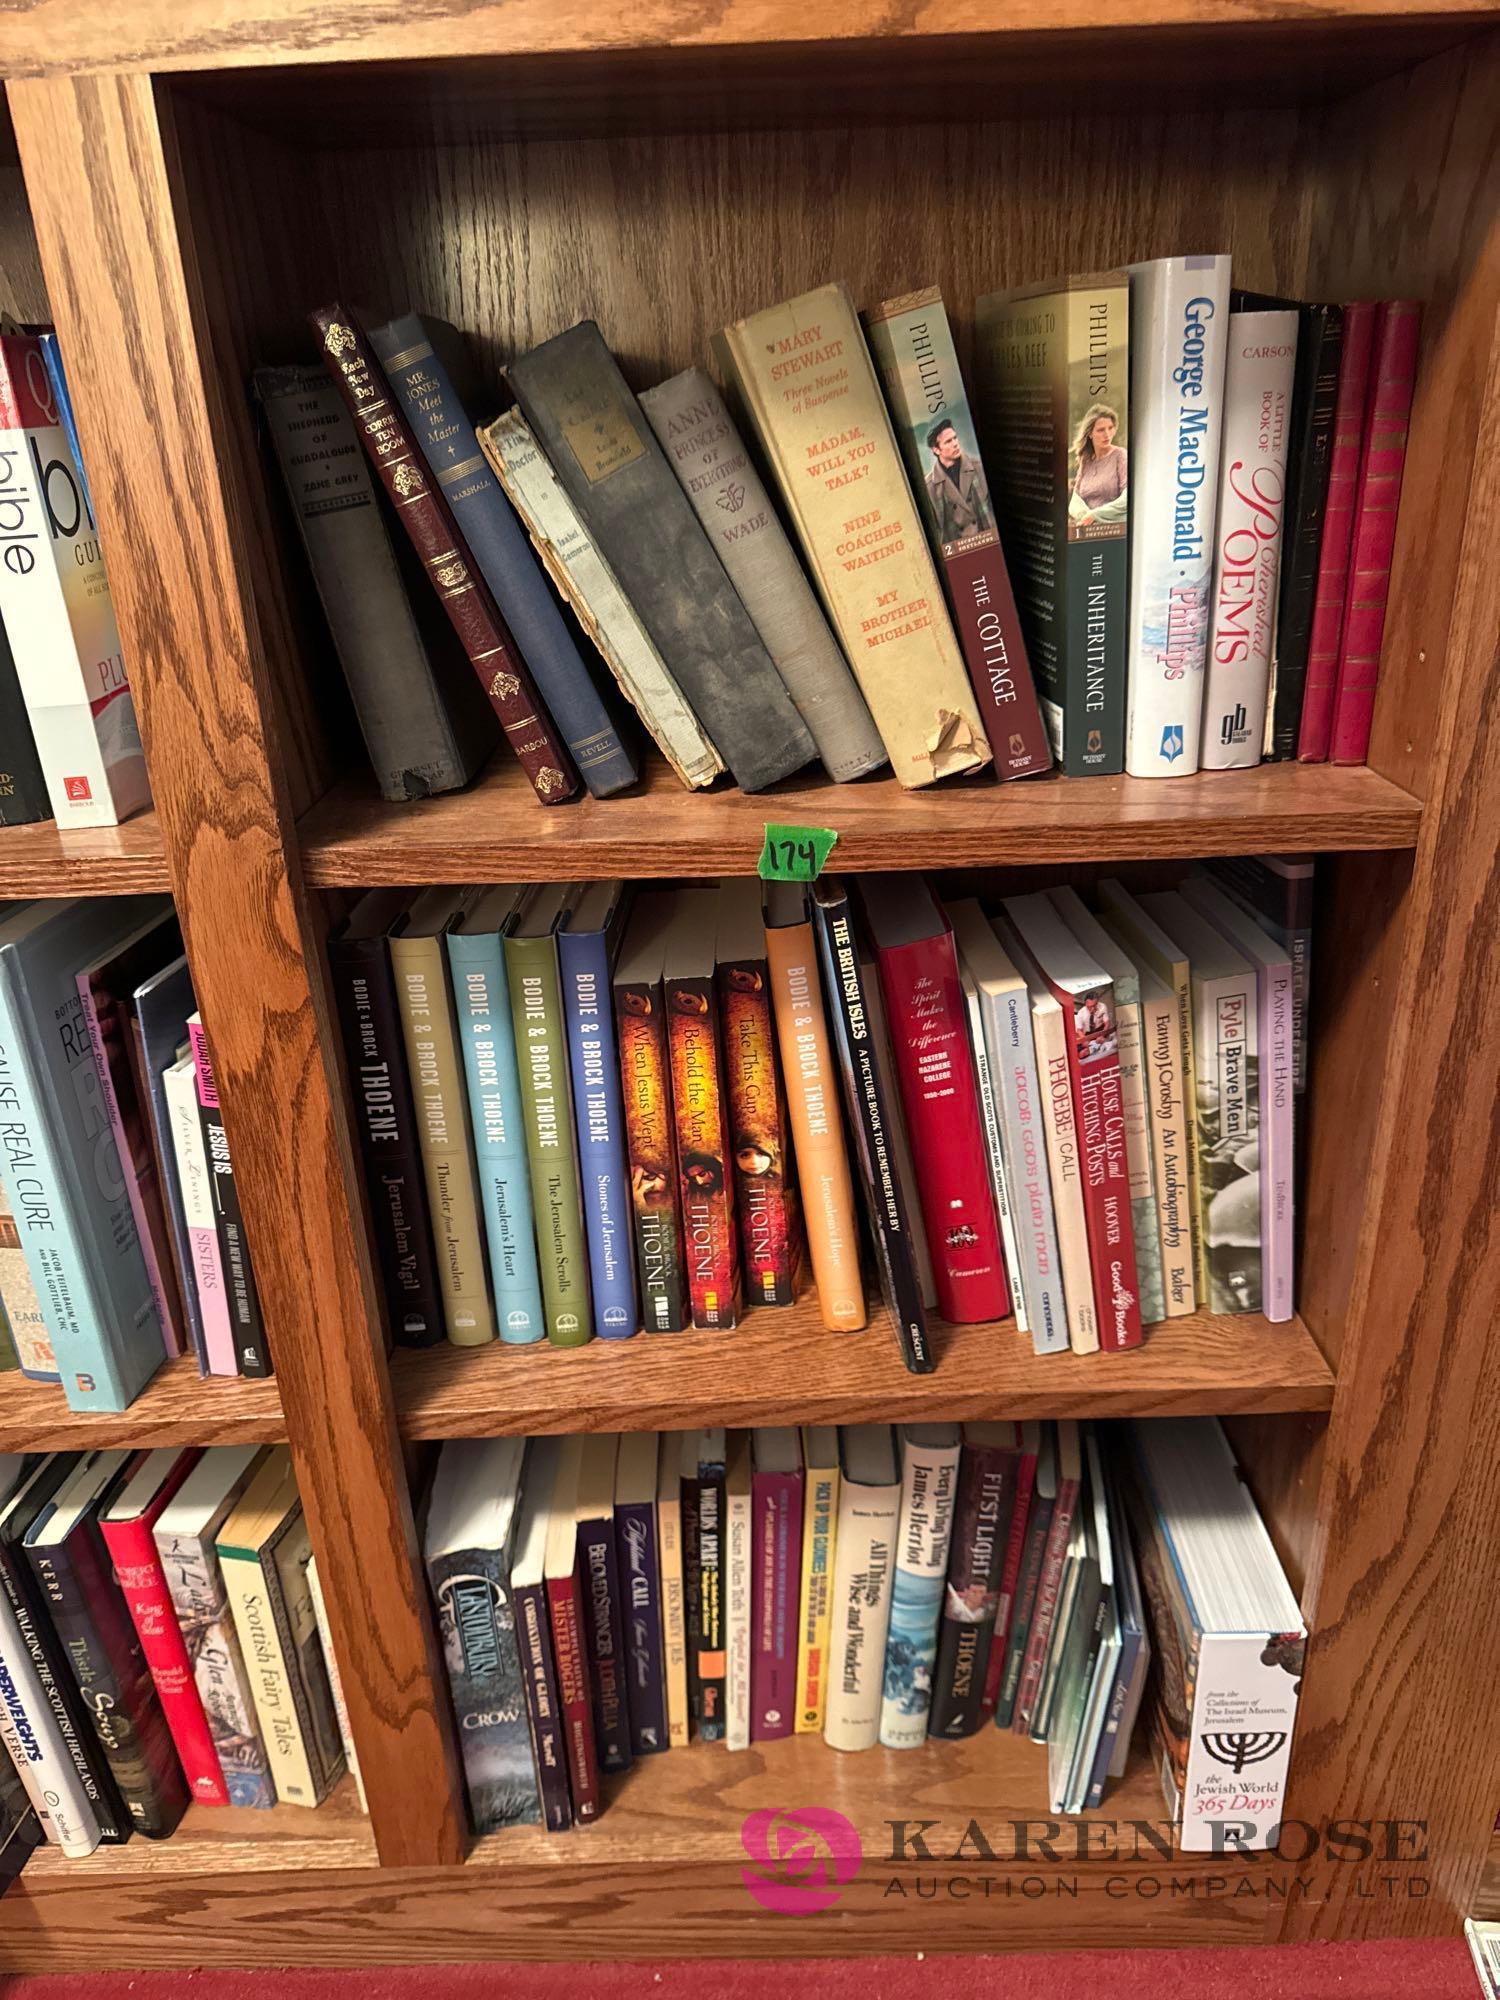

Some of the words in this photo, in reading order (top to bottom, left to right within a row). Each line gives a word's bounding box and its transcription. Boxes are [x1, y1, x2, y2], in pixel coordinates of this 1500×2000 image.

[777, 325, 823, 356] MARY
[1089, 303, 1109, 397] PHILLIPS
[1172, 296, 1215, 398] George
[1242, 345, 1295, 360] CARSON
[771, 340, 844, 382] STEWART
[909, 322, 947, 415] PHILLIPS
[298, 400, 320, 412] THE
[1259, 390, 1273, 431] BOOK
[313, 434, 328, 444] OF
[375, 428, 395, 442] TEN
[376, 436, 406, 456] BOOM
[674, 421, 731, 462] PRINCESS
[1258, 433, 1269, 453] OF
[508, 451, 537, 472] Doctor
[703, 451, 720, 465] OF
[806, 457, 846, 478] WILL
[849, 441, 877, 462] YOU
[452, 479, 492, 503] MARSHALL
[824, 464, 870, 492] TALK?
[1171, 406, 1209, 561] MacDonald
[722, 512, 770, 544] WADE
[835, 521, 903, 557] COACHES
[842, 509, 882, 535] NINE
[841, 539, 906, 573] WAITING
[1091, 554, 1103, 577] THE
[876, 590, 899, 608] MY
[971, 575, 991, 607] THE
[859, 598, 928, 633] BROTHER
[866, 616, 933, 649] MICHAEL
[1085, 583, 1106, 713] INHERITANCE
[1156, 587, 1202, 681] Phillips
[976, 612, 1017, 706] COTTAGE
[580, 740, 612, 758] REVELL
[769, 839, 816, 875] 174
[832, 917, 851, 948] THE
[787, 966, 811, 1011] BODIE
[838, 947, 861, 1002] BRITISH
[914, 977, 934, 990] The
[405, 974, 431, 1017] BODIE
[466, 973, 490, 1016] BODIE
[522, 977, 545, 1021] BODIE
[575, 973, 598, 1016] BODIE
[1273, 979, 1288, 1035] PLAYING
[414, 1024, 432, 1034] &
[473, 1024, 491, 1033] &
[528, 1027, 547, 1037] &
[581, 1024, 600, 1033] &
[739, 1014, 757, 1049] Take
[794, 1016, 813, 1028] &
[847, 1002, 868, 1041] ISLES
[922, 1019, 938, 1032] the
[1007, 998, 1020, 1048] Cantleberry
[1219, 1000, 1243, 1039] Pyle
[416, 1041, 441, 1087] BROCK
[475, 1041, 499, 1087] BROCK
[529, 1045, 553, 1091] BROCK
[582, 1040, 604, 1086] BROCK
[684, 1027, 705, 1080] Behold
[741, 1051, 760, 1083] This
[796, 1033, 821, 1081] BROCK
[859, 1049, 868, 1058] A
[1273, 1039, 1286, 1063] THE
[860, 1059, 877, 1102] PICTURE
[923, 1070, 952, 1084] COLLEGE
[978, 1054, 989, 1086] STRANGE
[1226, 1045, 1243, 1095] Brave
[1273, 1067, 1288, 1109] HAND
[687, 1082, 705, 1106] the
[742, 1083, 761, 1115] Cup
[803, 1084, 828, 1137] THOENE
[983, 1086, 992, 1101] OLD
[1048, 1055, 1073, 1135] PHOEBE
[1081, 1072, 1102, 1144] HITCHING
[423, 1094, 449, 1144] THOENE
[481, 1092, 506, 1144] THOENE
[535, 1096, 559, 1148] THOENE
[587, 1092, 609, 1143] THOENE
[690, 1108, 706, 1145] Man
[868, 1102, 882, 1132] BOOK
[985, 1101, 995, 1123] SCOTS
[1226, 1097, 1243, 1135] Men
[874, 1132, 884, 1147] TO
[988, 1122, 999, 1154] CUSTOMS
[875, 1147, 895, 1198] REMEMBER
[992, 1154, 1002, 1170] AND
[1060, 1142, 1076, 1183] CALL
[1087, 1142, 1105, 1187] POSTS
[548, 1174, 561, 1196] The
[597, 1174, 611, 1213] Stones
[994, 1168, 1008, 1217] SUPERSTITIONS
[494, 1178, 515, 1246] Jerusalem's
[602, 1213, 612, 1224] of
[749, 1184, 772, 1264] THOENE
[885, 1197, 898, 1217] HER
[889, 1216, 901, 1232] BY
[1103, 1195, 1121, 1246] HOOVER
[226, 1222, 239, 1242] FIND
[550, 1199, 567, 1260] Jerusalem
[691, 1204, 715, 1283] THOENE
[196, 1233, 218, 1290] SISTERS
[229, 1246, 242, 1264] NEW
[503, 1244, 516, 1278] Heart
[602, 1221, 615, 1281] Jerusalem
[640, 1212, 665, 1292] THOENE
[231, 1264, 245, 1281] WAY
[235, 1280, 246, 1291] TO
[555, 1256, 572, 1293] Scrolls
[48, 1248, 64, 1272] JACOB
[56, 1272, 76, 1322] TEITELBAUM,
[71, 1321, 80, 1334] MD
[236, 1290, 248, 1300] BE
[237, 1300, 251, 1324] HUMAN
[911, 1463, 934, 1511] James
[932, 1464, 955, 1500] Every
[700, 1487, 718, 1531] WORLDS
[930, 1499, 951, 1535] Living
[700, 1532, 718, 1570] APART:
[871, 1539, 888, 1560] All
[906, 1510, 929, 1566] Herriot
[925, 1532, 948, 1568] Thing
[631, 1576, 650, 1611] CALL
[850, 1573, 868, 1605] Wise
[864, 1562, 886, 1608] Things
[242, 1592, 277, 1664] Scottish
[553, 1599, 571, 1656] MISTER
[847, 1606, 862, 1632] and
[560, 1655, 576, 1705] ROGERS
[842, 1632, 864, 1695] Wonderful
[259, 1668, 282, 1714] Fairy
[1226, 1689, 1240, 1699] the
[462, 1709, 520, 1731] CROW
[1203, 1716, 1244, 1726] Jerusalem
[1206, 1707, 1222, 1716] The
[1223, 1706, 1247, 1715] Israel
[1248, 1706, 1288, 1716] Museum,
[271, 1716, 297, 1757] Tales
[1193, 1780, 1237, 1798] Jewish
[1238, 1782, 1279, 1794] World
[1205, 1774, 1222, 1784] the
[1193, 1796, 1227, 1815] 365
[1228, 1794, 1277, 1815] Days
[55, 1812, 71, 1842] Schiffer
